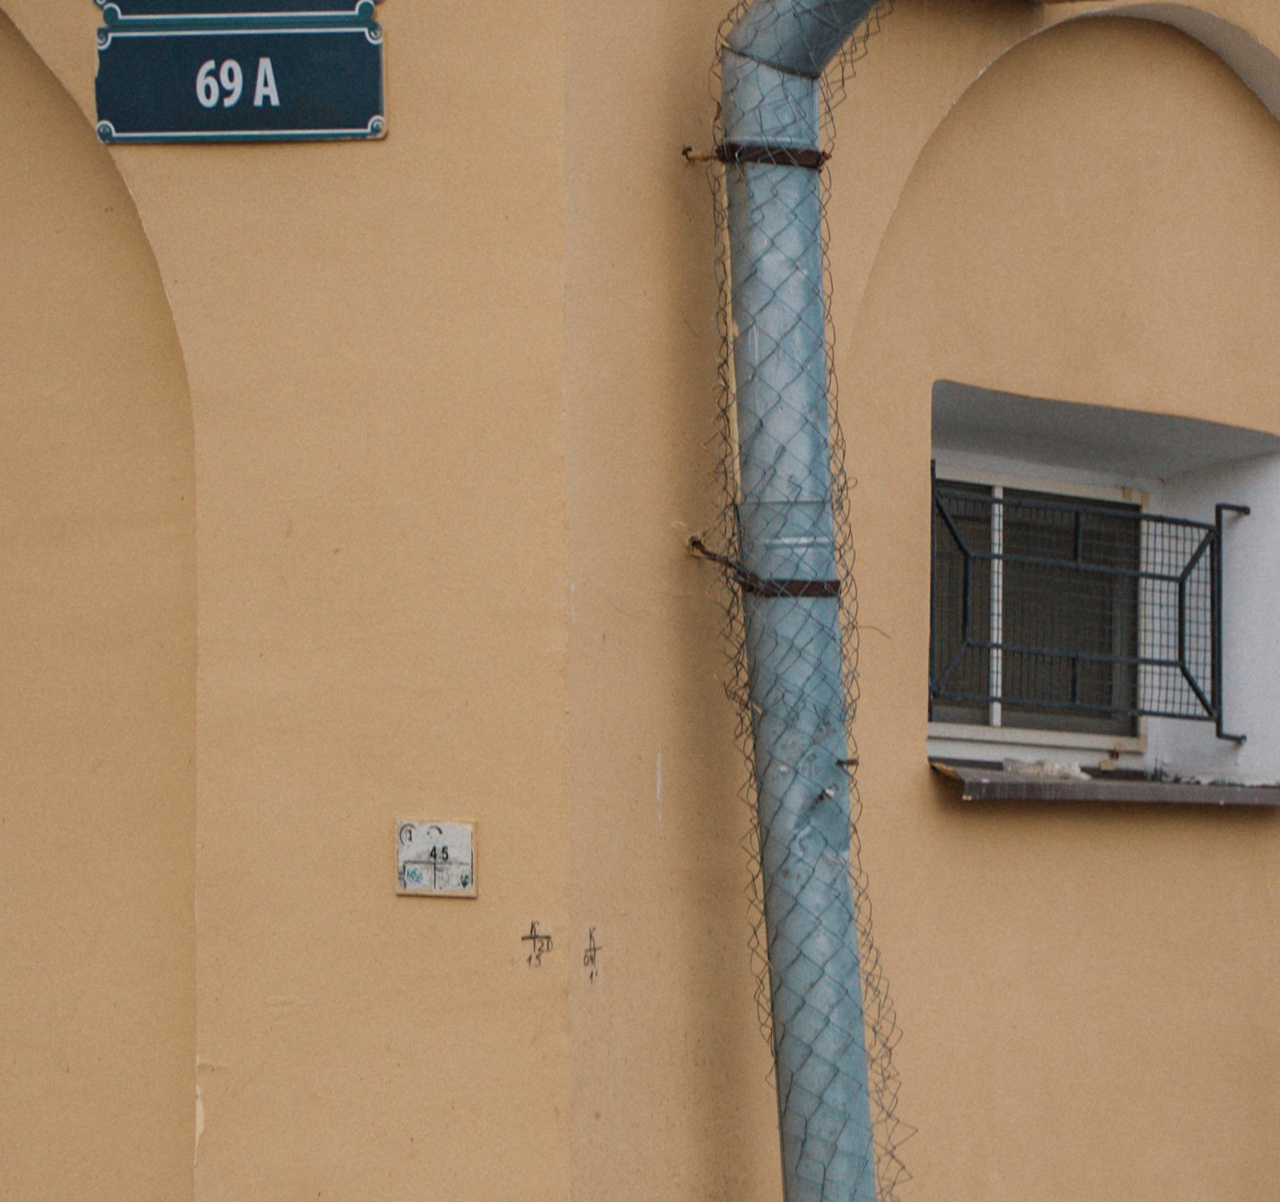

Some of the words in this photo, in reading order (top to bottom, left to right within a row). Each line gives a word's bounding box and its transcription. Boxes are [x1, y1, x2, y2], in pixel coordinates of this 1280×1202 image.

[195, 59, 243, 108] 69
[253, 57, 280, 107] A
[429, 845, 449, 862] 45
